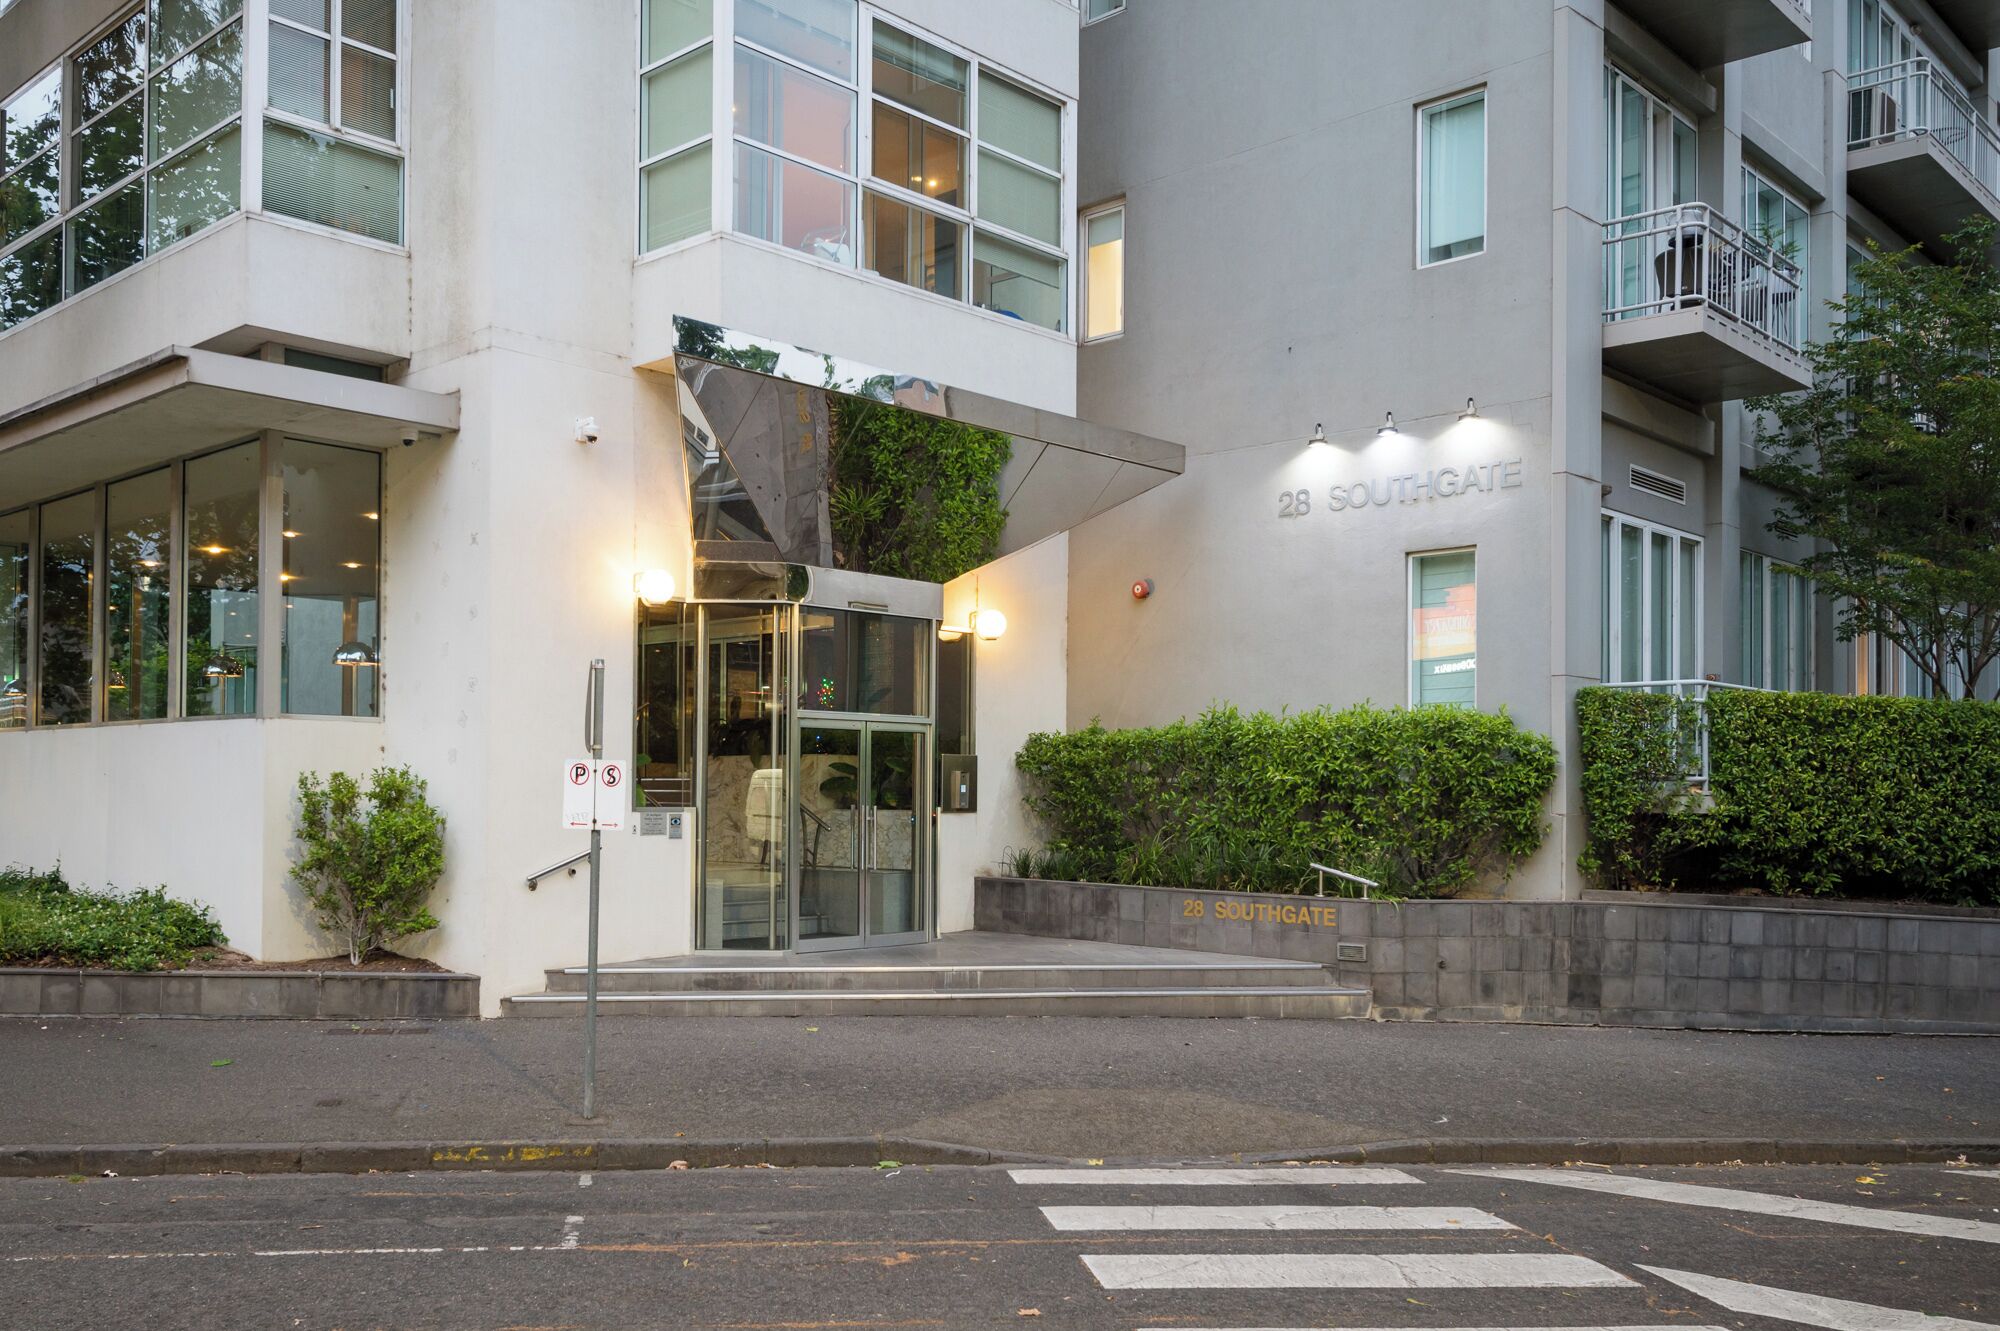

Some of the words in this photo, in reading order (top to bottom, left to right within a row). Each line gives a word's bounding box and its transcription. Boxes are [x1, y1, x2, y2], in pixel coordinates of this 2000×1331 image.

[1278, 489, 1310, 518] 28
[1328, 457, 1522, 512] SOUTHGATE
[1183, 900, 1205, 918] 28
[1215, 902, 1337, 927] SOUTHGATE
